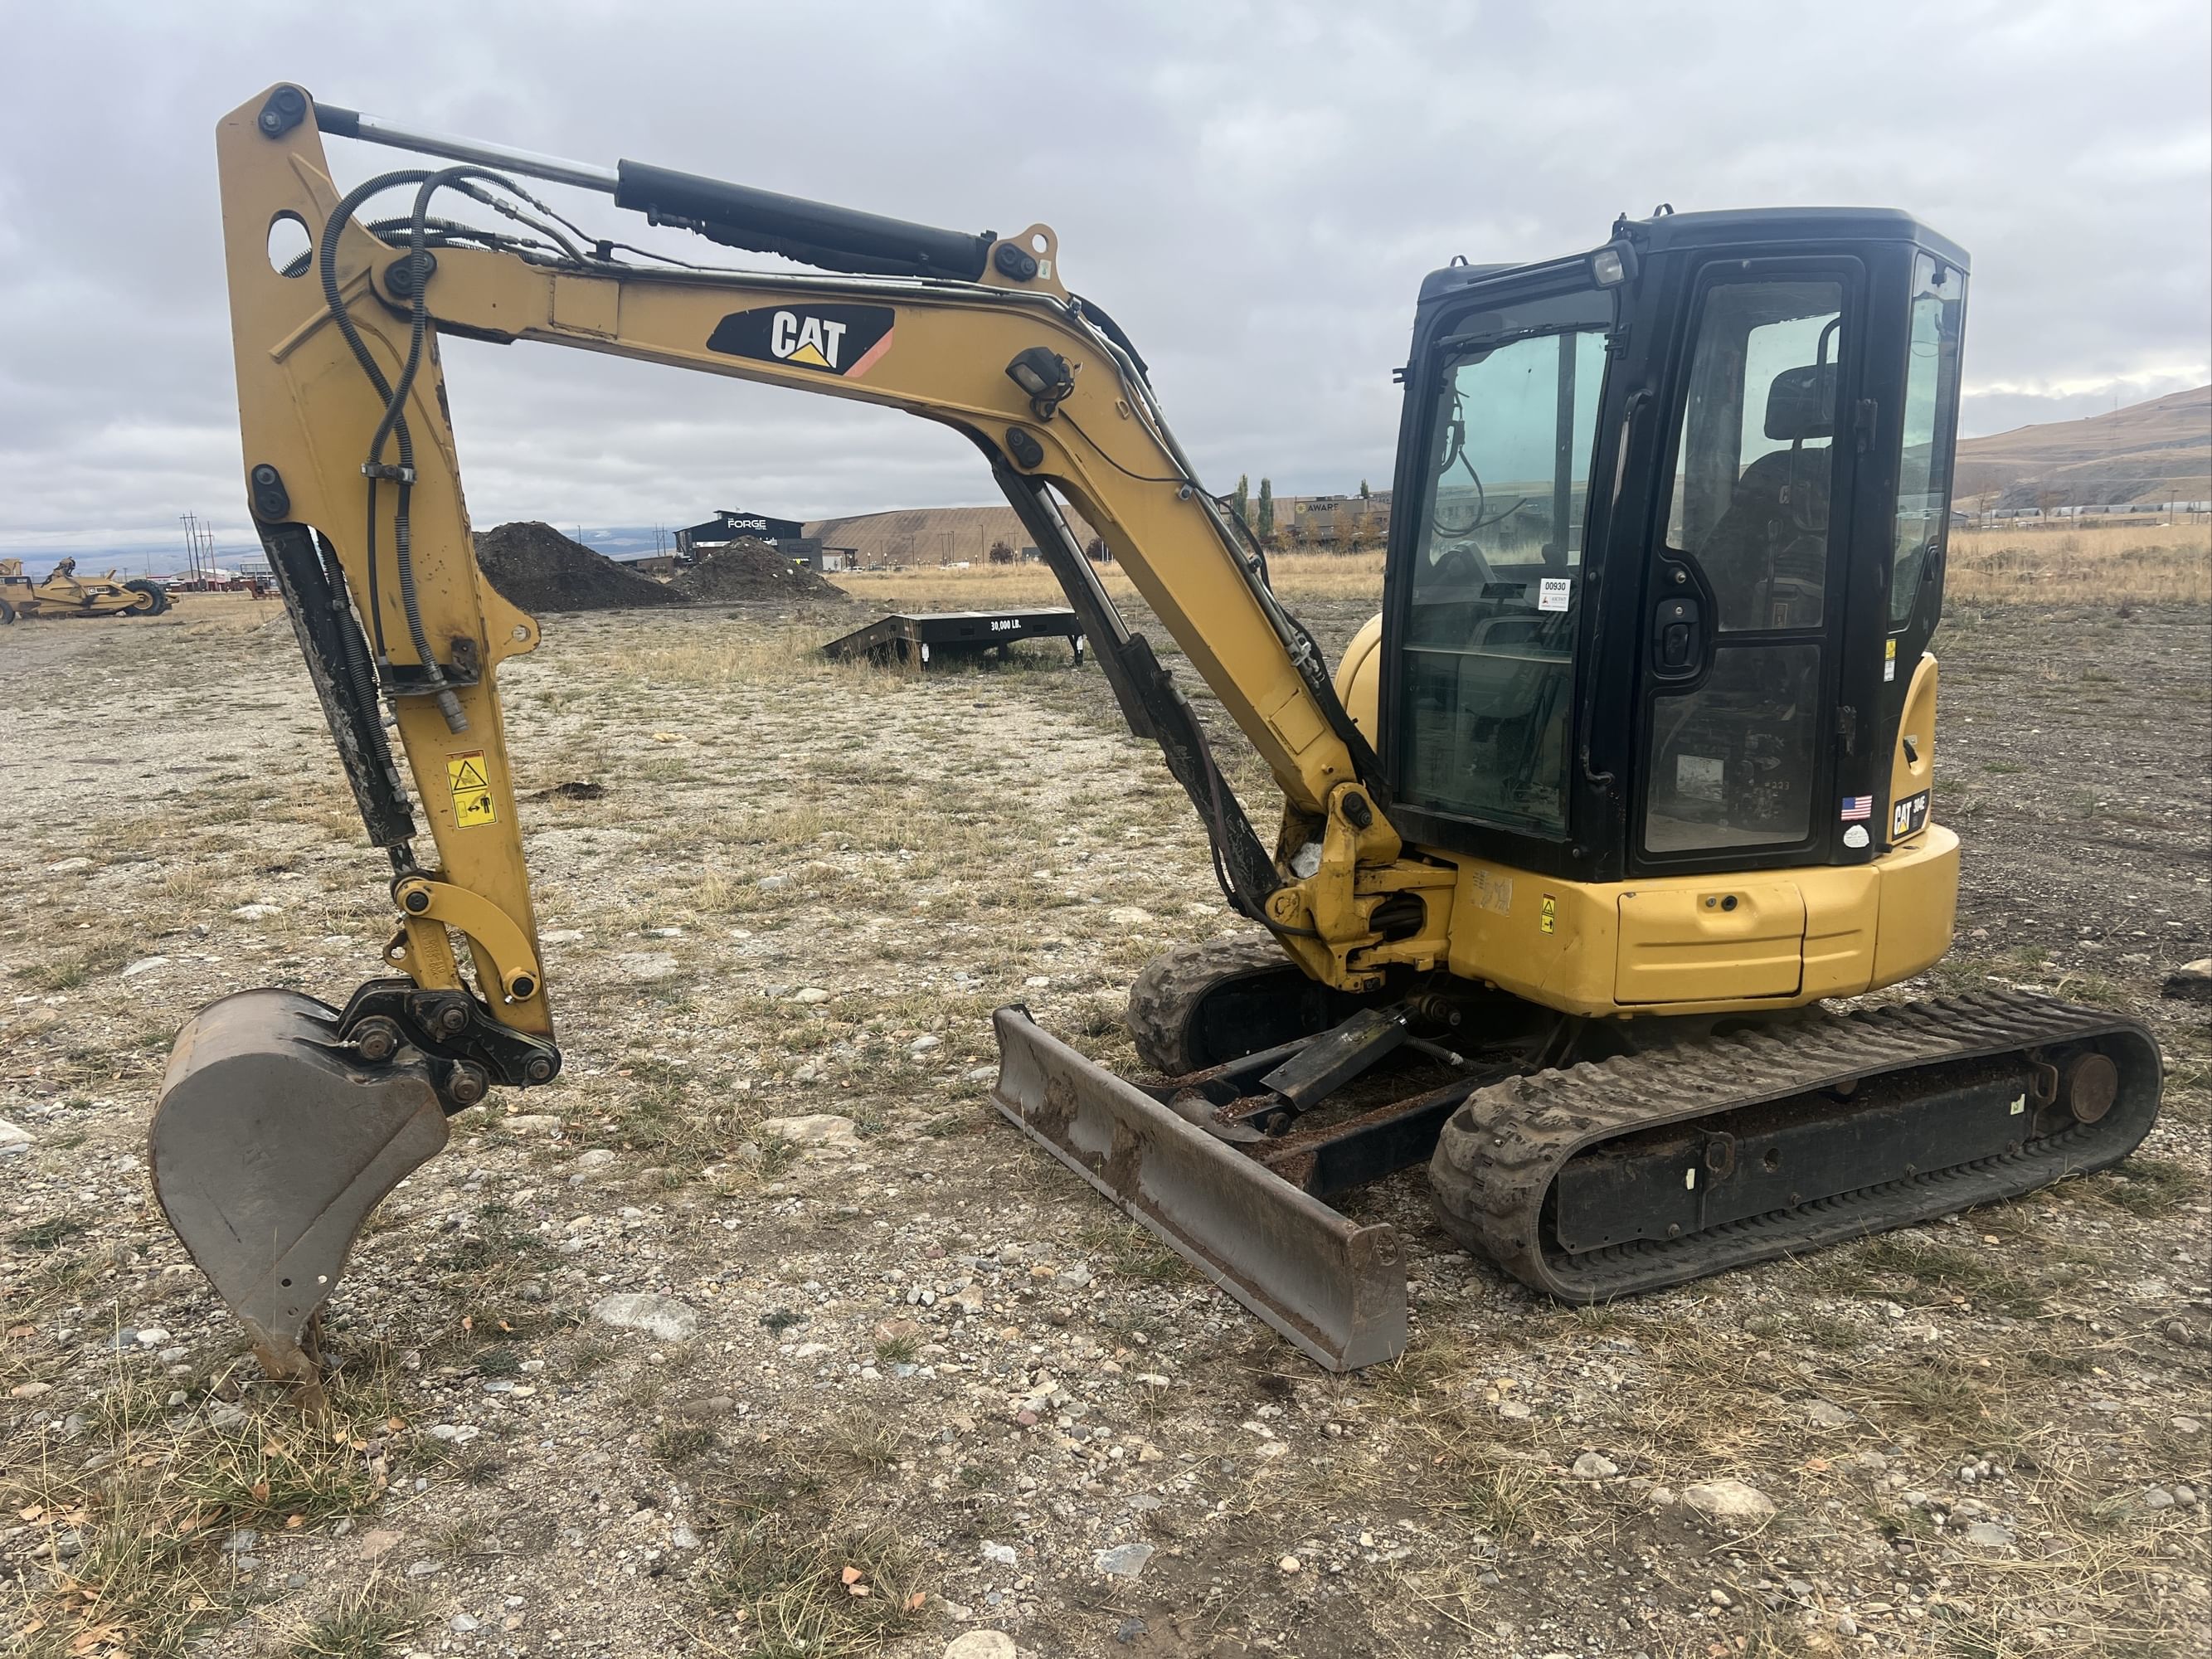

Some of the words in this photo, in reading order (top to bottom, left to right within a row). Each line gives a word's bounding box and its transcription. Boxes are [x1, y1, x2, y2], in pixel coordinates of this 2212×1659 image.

[771, 310, 847, 368] CAT
[1307, 503, 1339, 512] AWARE
[727, 519, 766, 528] FORGE
[1545, 581, 1566, 591] 00930
[990, 620, 1011, 631] 30,000
[1012, 619, 1022, 629] LB.
[1894, 801, 1913, 835] CAT
